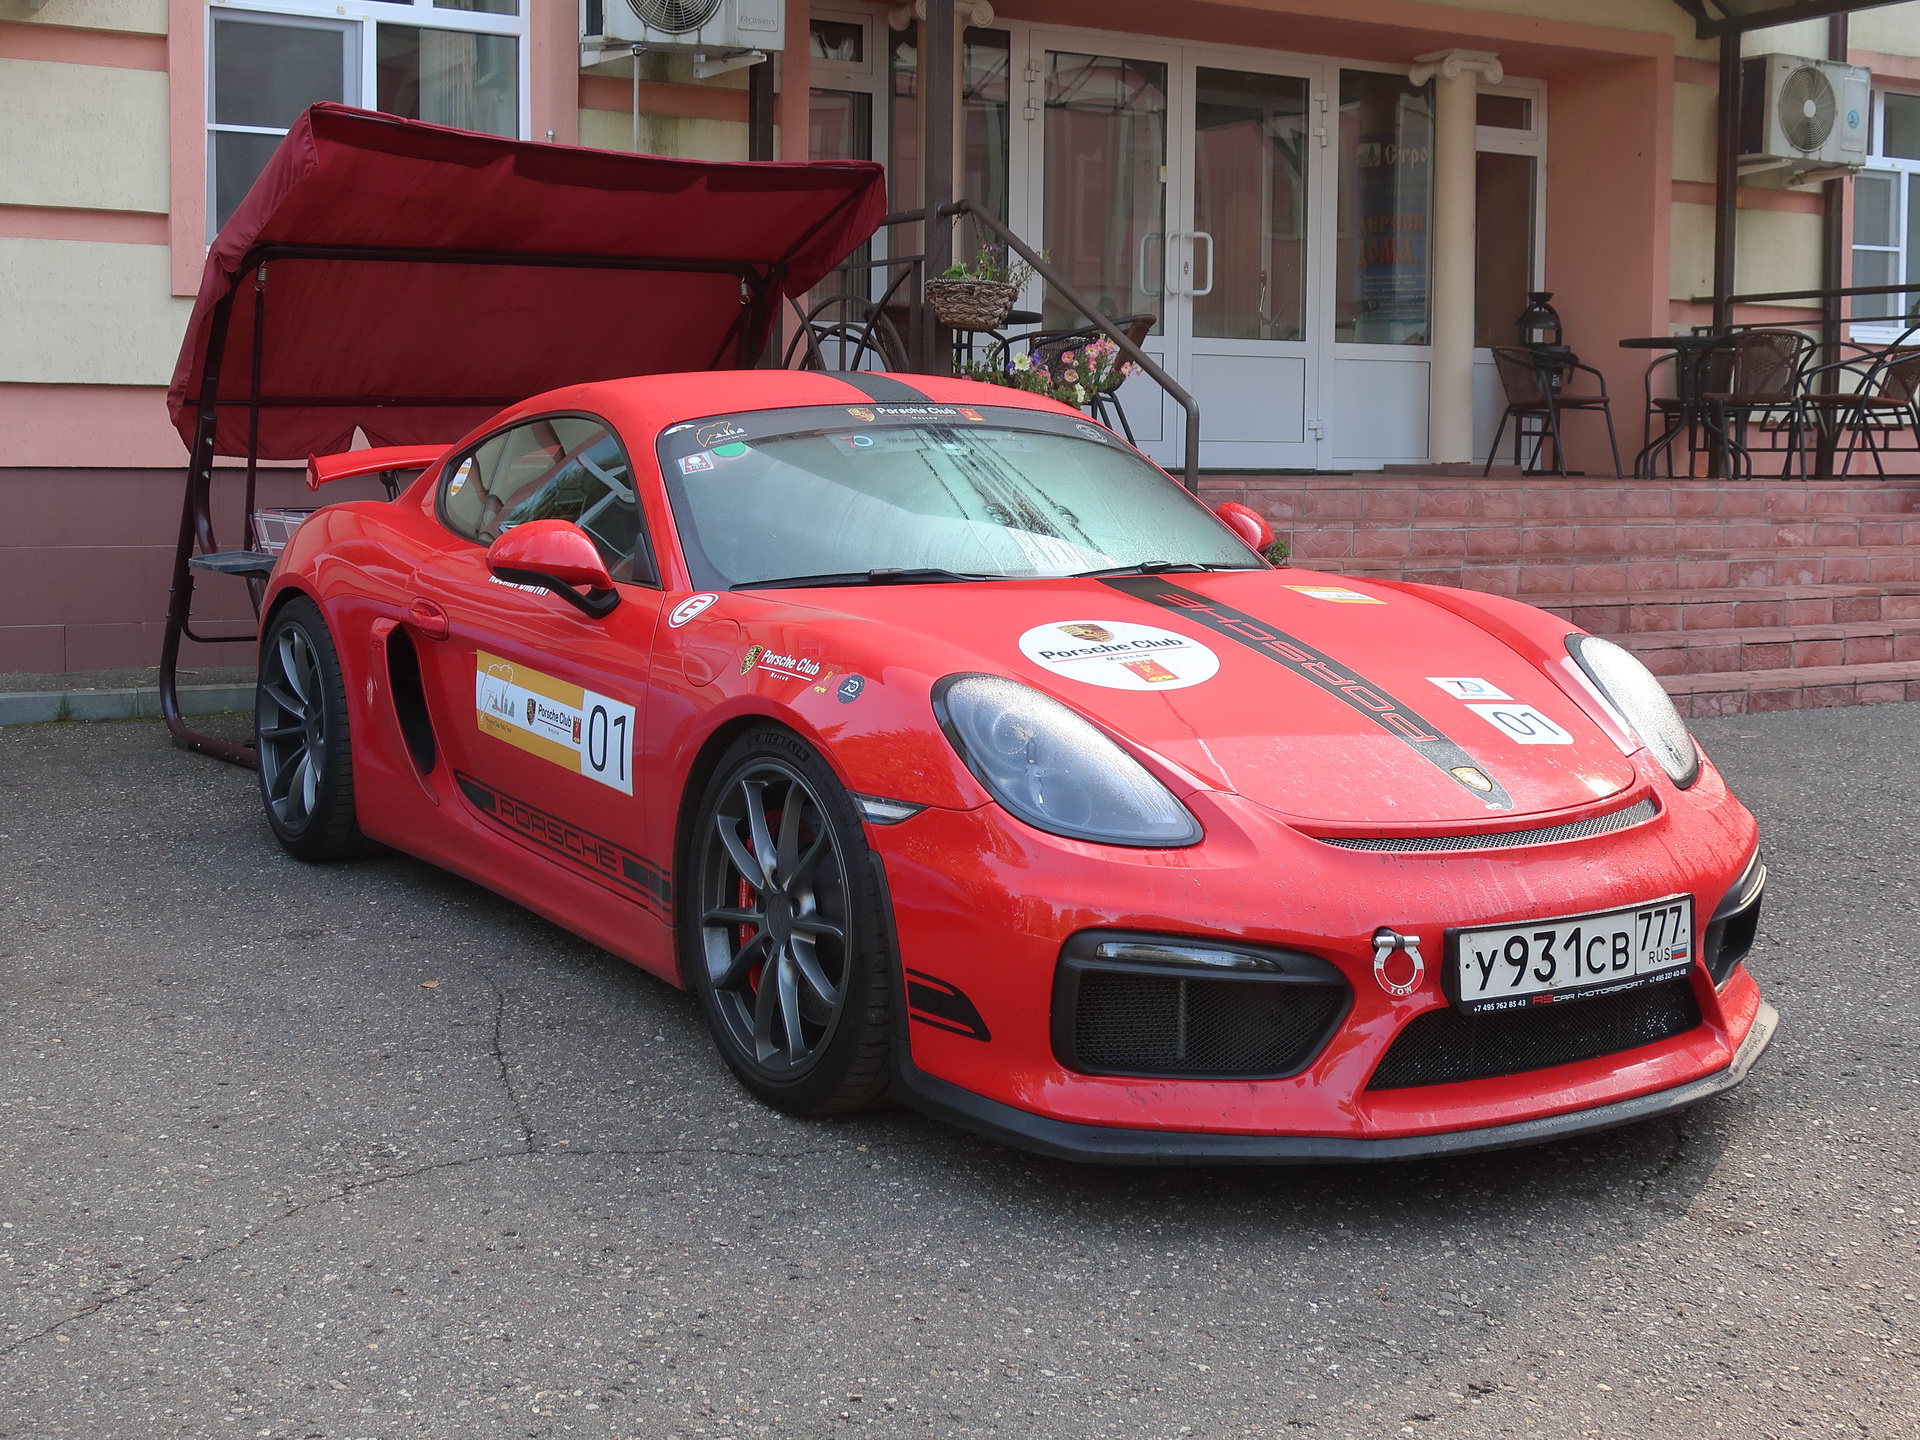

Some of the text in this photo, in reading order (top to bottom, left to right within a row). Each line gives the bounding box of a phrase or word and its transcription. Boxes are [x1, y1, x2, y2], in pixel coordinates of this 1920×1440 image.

[876, 406, 957, 415] Porsche Club
[1039, 637, 1184, 660] Porsche Club
[1106, 653, 1152, 661] Moscow
[760, 649, 820, 676] Porsche Club
[1155, 593, 1441, 743] PORSCHE
[769, 671, 789, 681] Moscow
[537, 703, 572, 728] Porsche Club
[1492, 711, 1561, 736] 01
[588, 704, 627, 782] 01
[757, 732, 810, 761] MICHELIN
[500, 799, 618, 873] PORSCHE
[1638, 905, 1683, 951] 777
[1649, 946, 1671, 964] RUS
[1390, 986, 1413, 996] TOW
[1577, 979, 1645, 998] MOTORSPORT
[1473, 999, 1526, 1013] +7 495 762 85 43
